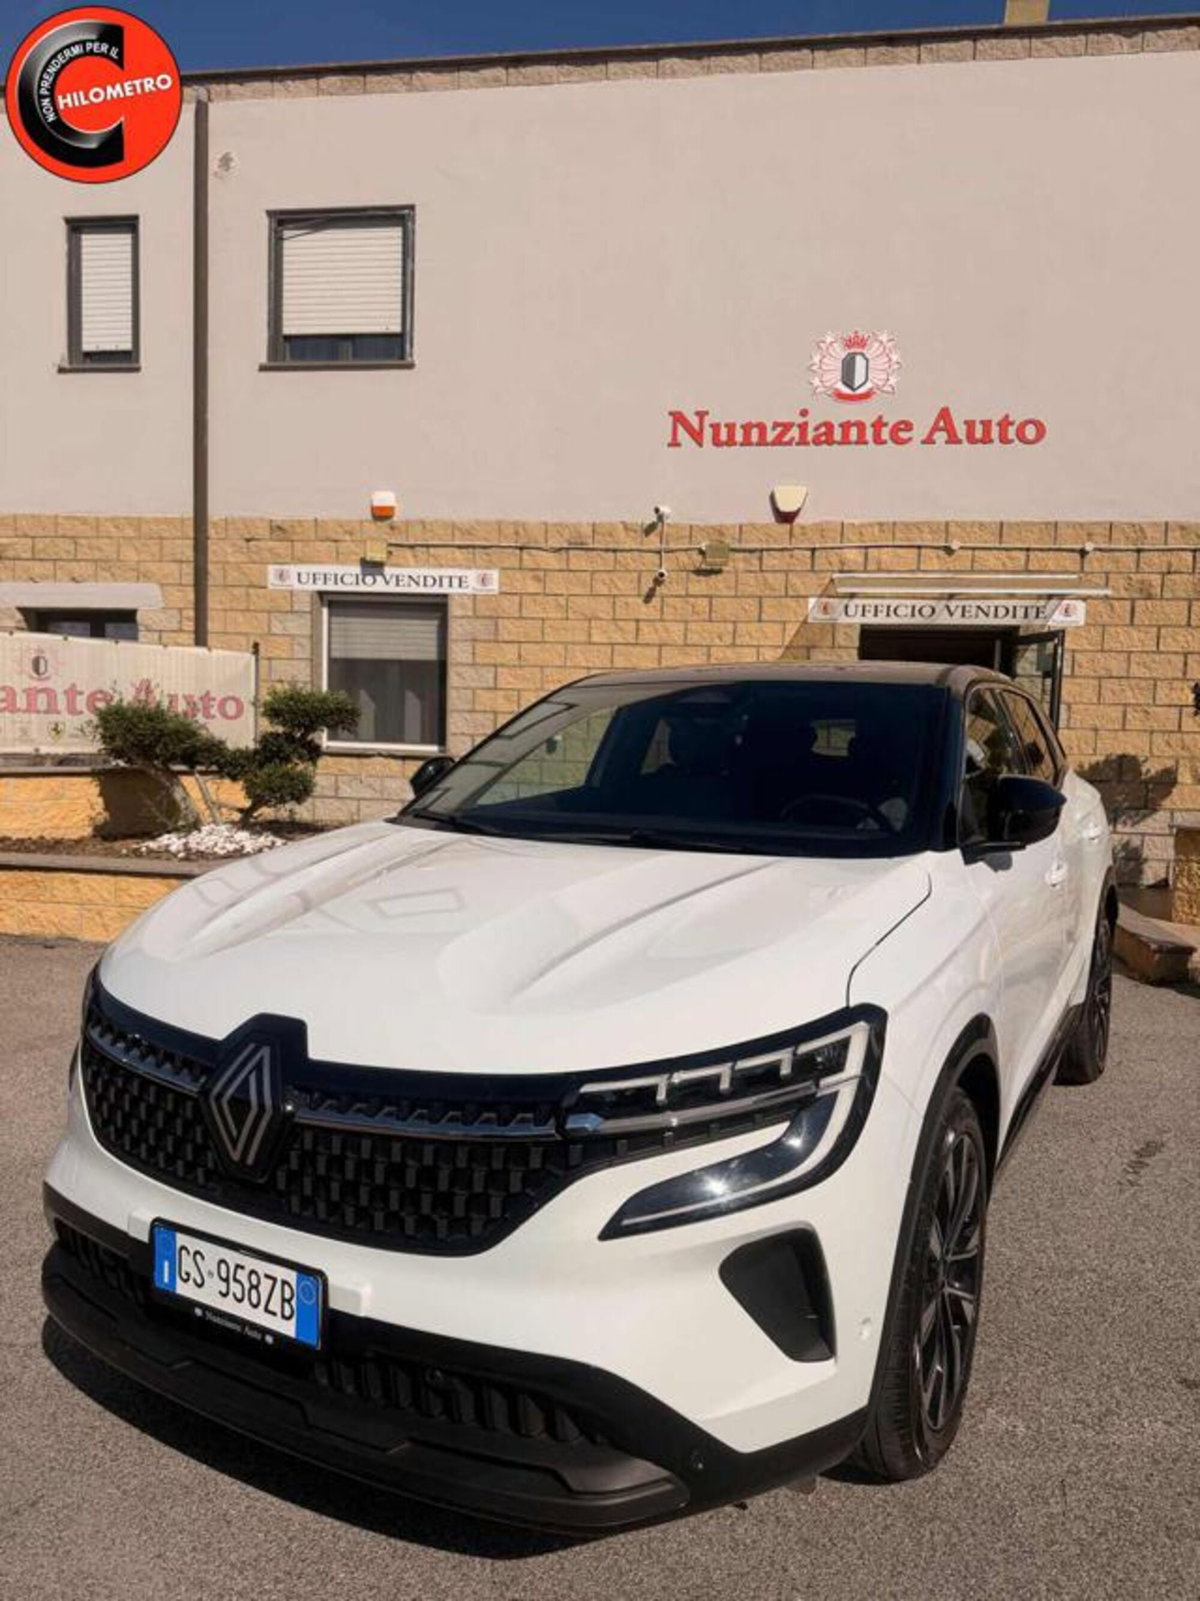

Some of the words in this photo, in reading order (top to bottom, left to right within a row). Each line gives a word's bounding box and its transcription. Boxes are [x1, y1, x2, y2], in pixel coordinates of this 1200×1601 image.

[666, 408, 915, 448] Nunziante
[920, 406, 1047, 446] Auto
[296, 571, 377, 587] UFFICIO
[377, 574, 470, 589] VENDITE
[843, 602, 936, 619] UFFICIO
[944, 603, 1049, 621] VENDITE
[178, 1244, 206, 1289] GS
[216, 1258, 296, 1322] 958ZB
